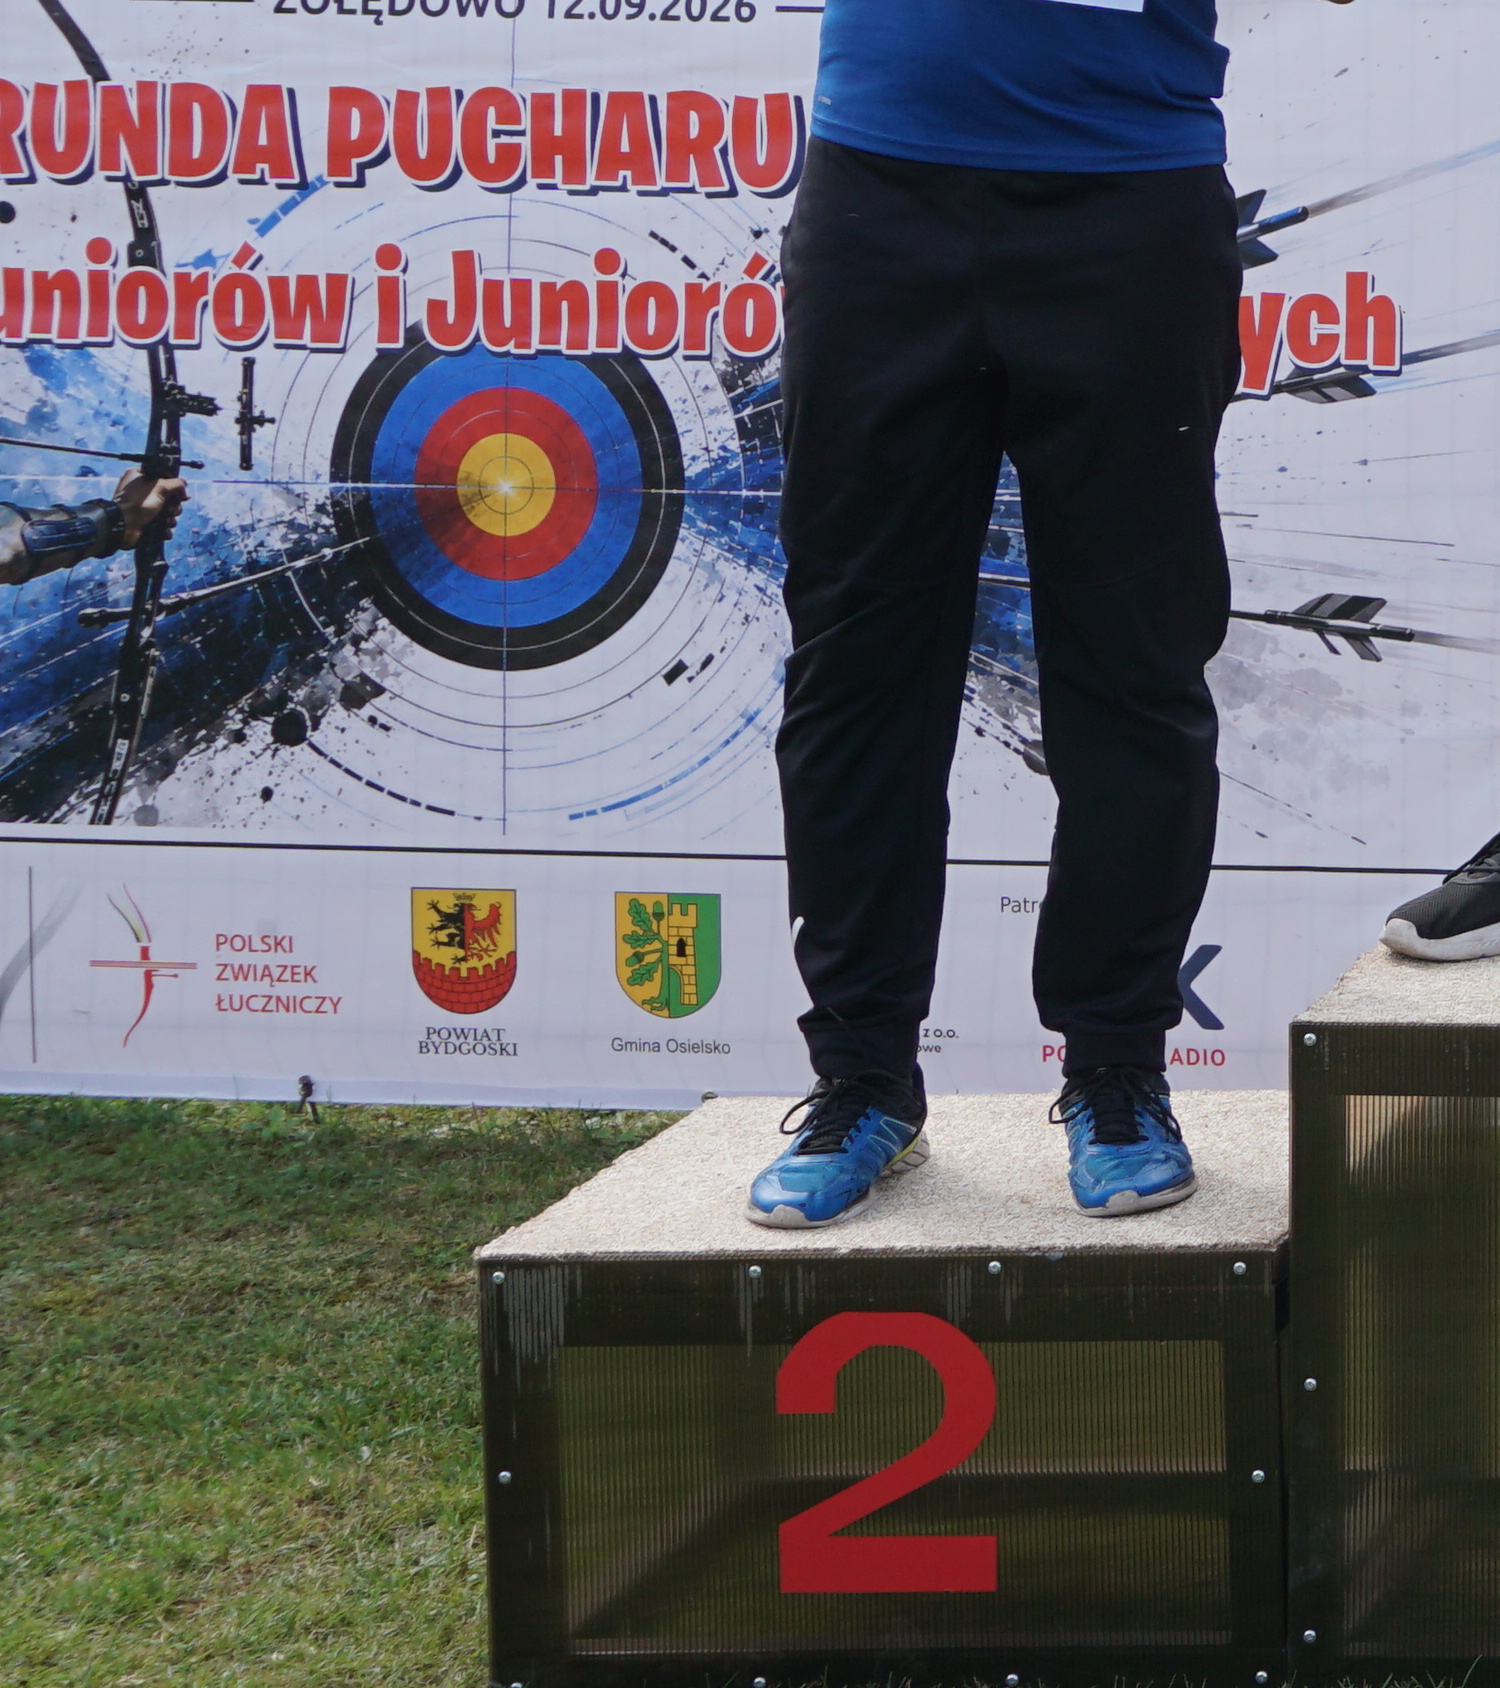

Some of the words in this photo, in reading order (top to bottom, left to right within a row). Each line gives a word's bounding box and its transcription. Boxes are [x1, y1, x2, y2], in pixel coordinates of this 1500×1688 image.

[0, 78, 297, 182] RUNDA
[326, 85, 800, 192] PUCHARU
[374, 242, 405, 348] i
[425, 247, 788, 358] Junioró
[214, 933, 294, 956] POLSKI
[215, 962, 318, 990] ZWIĄZEK
[214, 991, 343, 1016] ŁUCZNICZY
[425, 1026, 507, 1042] POWIAT
[610, 1036, 661, 1055] Gmina
[665, 1036, 732, 1056] Osielsko
[418, 1040, 519, 1058] BYDGOSKI
[1169, 1048, 1226, 1067] ADIO
[776, 1312, 996, 1593] 2
